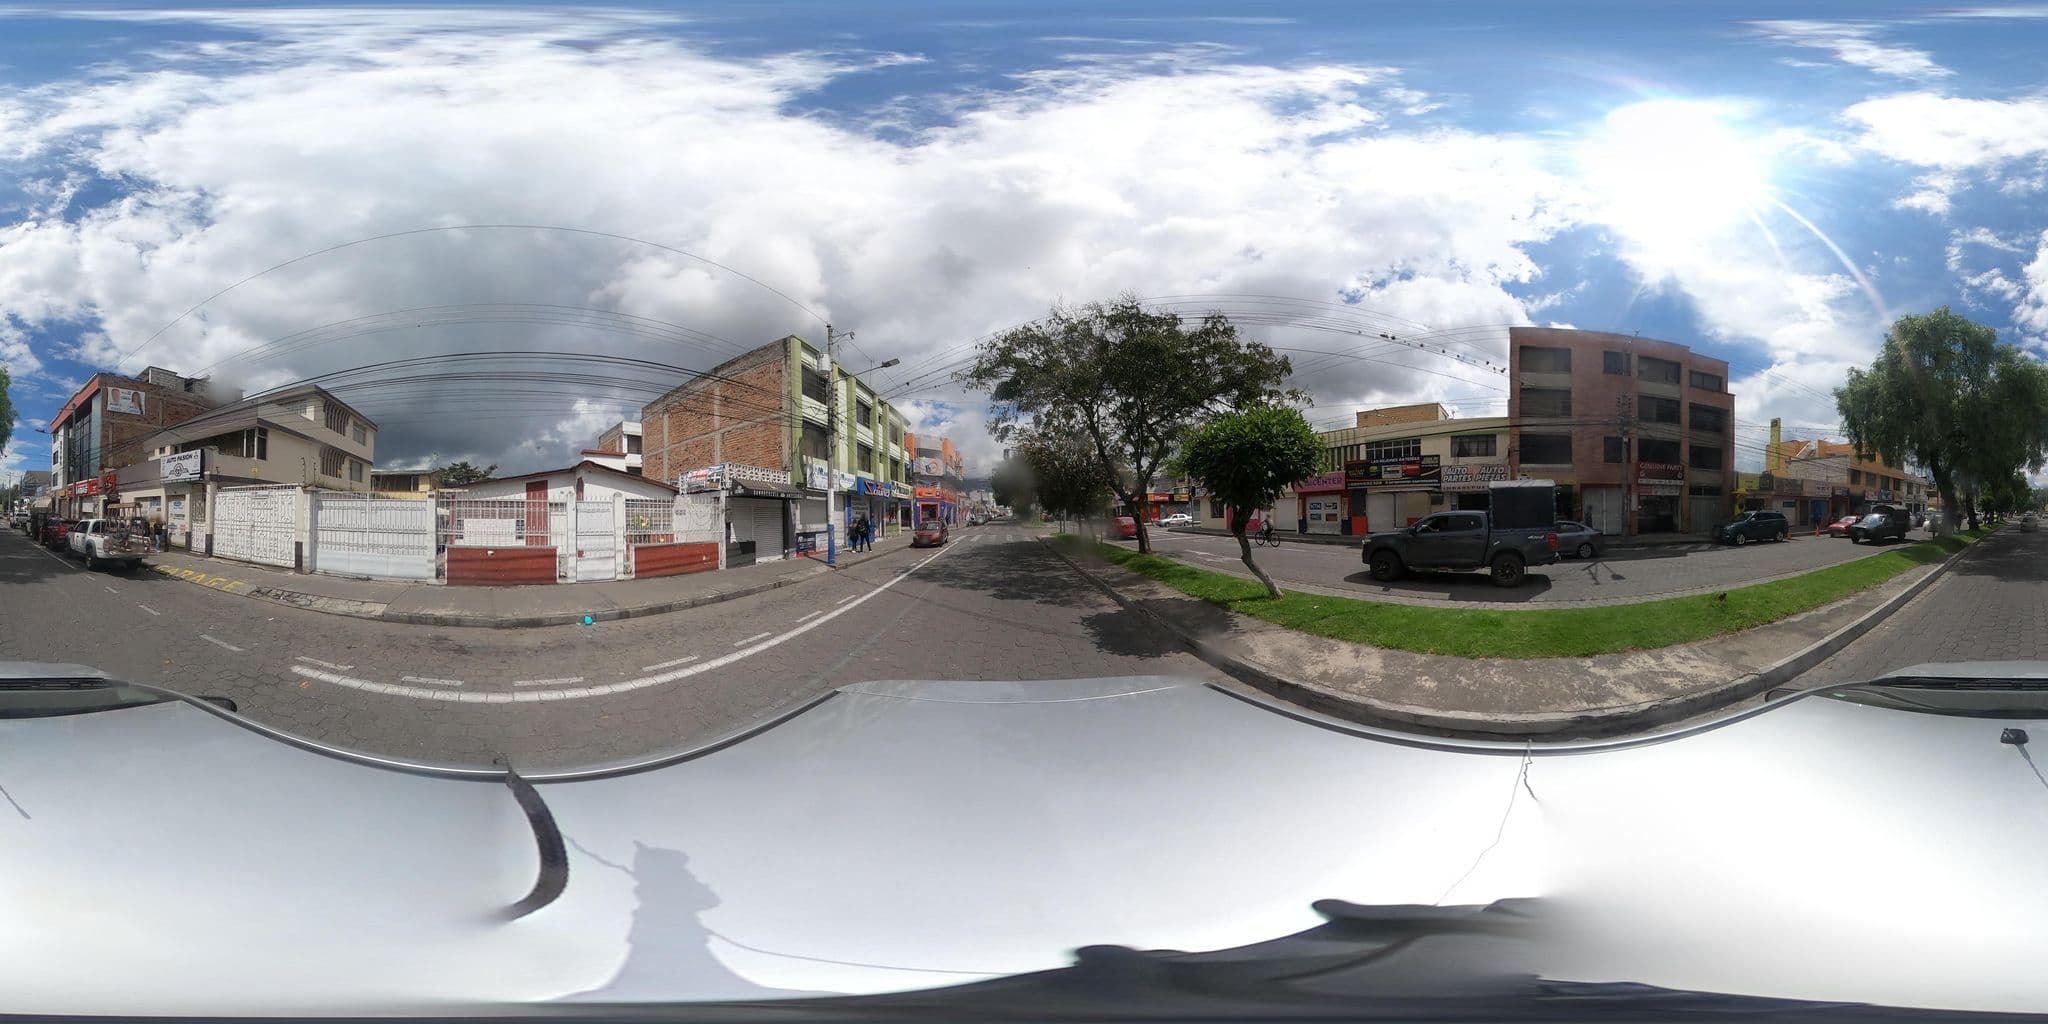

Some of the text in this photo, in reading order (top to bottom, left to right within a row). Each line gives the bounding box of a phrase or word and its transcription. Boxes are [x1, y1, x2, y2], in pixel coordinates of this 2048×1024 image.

[1447, 466, 1504, 475] AUTO AUTO
[1443, 474, 1472, 482] PARTES
[1476, 473, 1506, 481] PIEZAS
